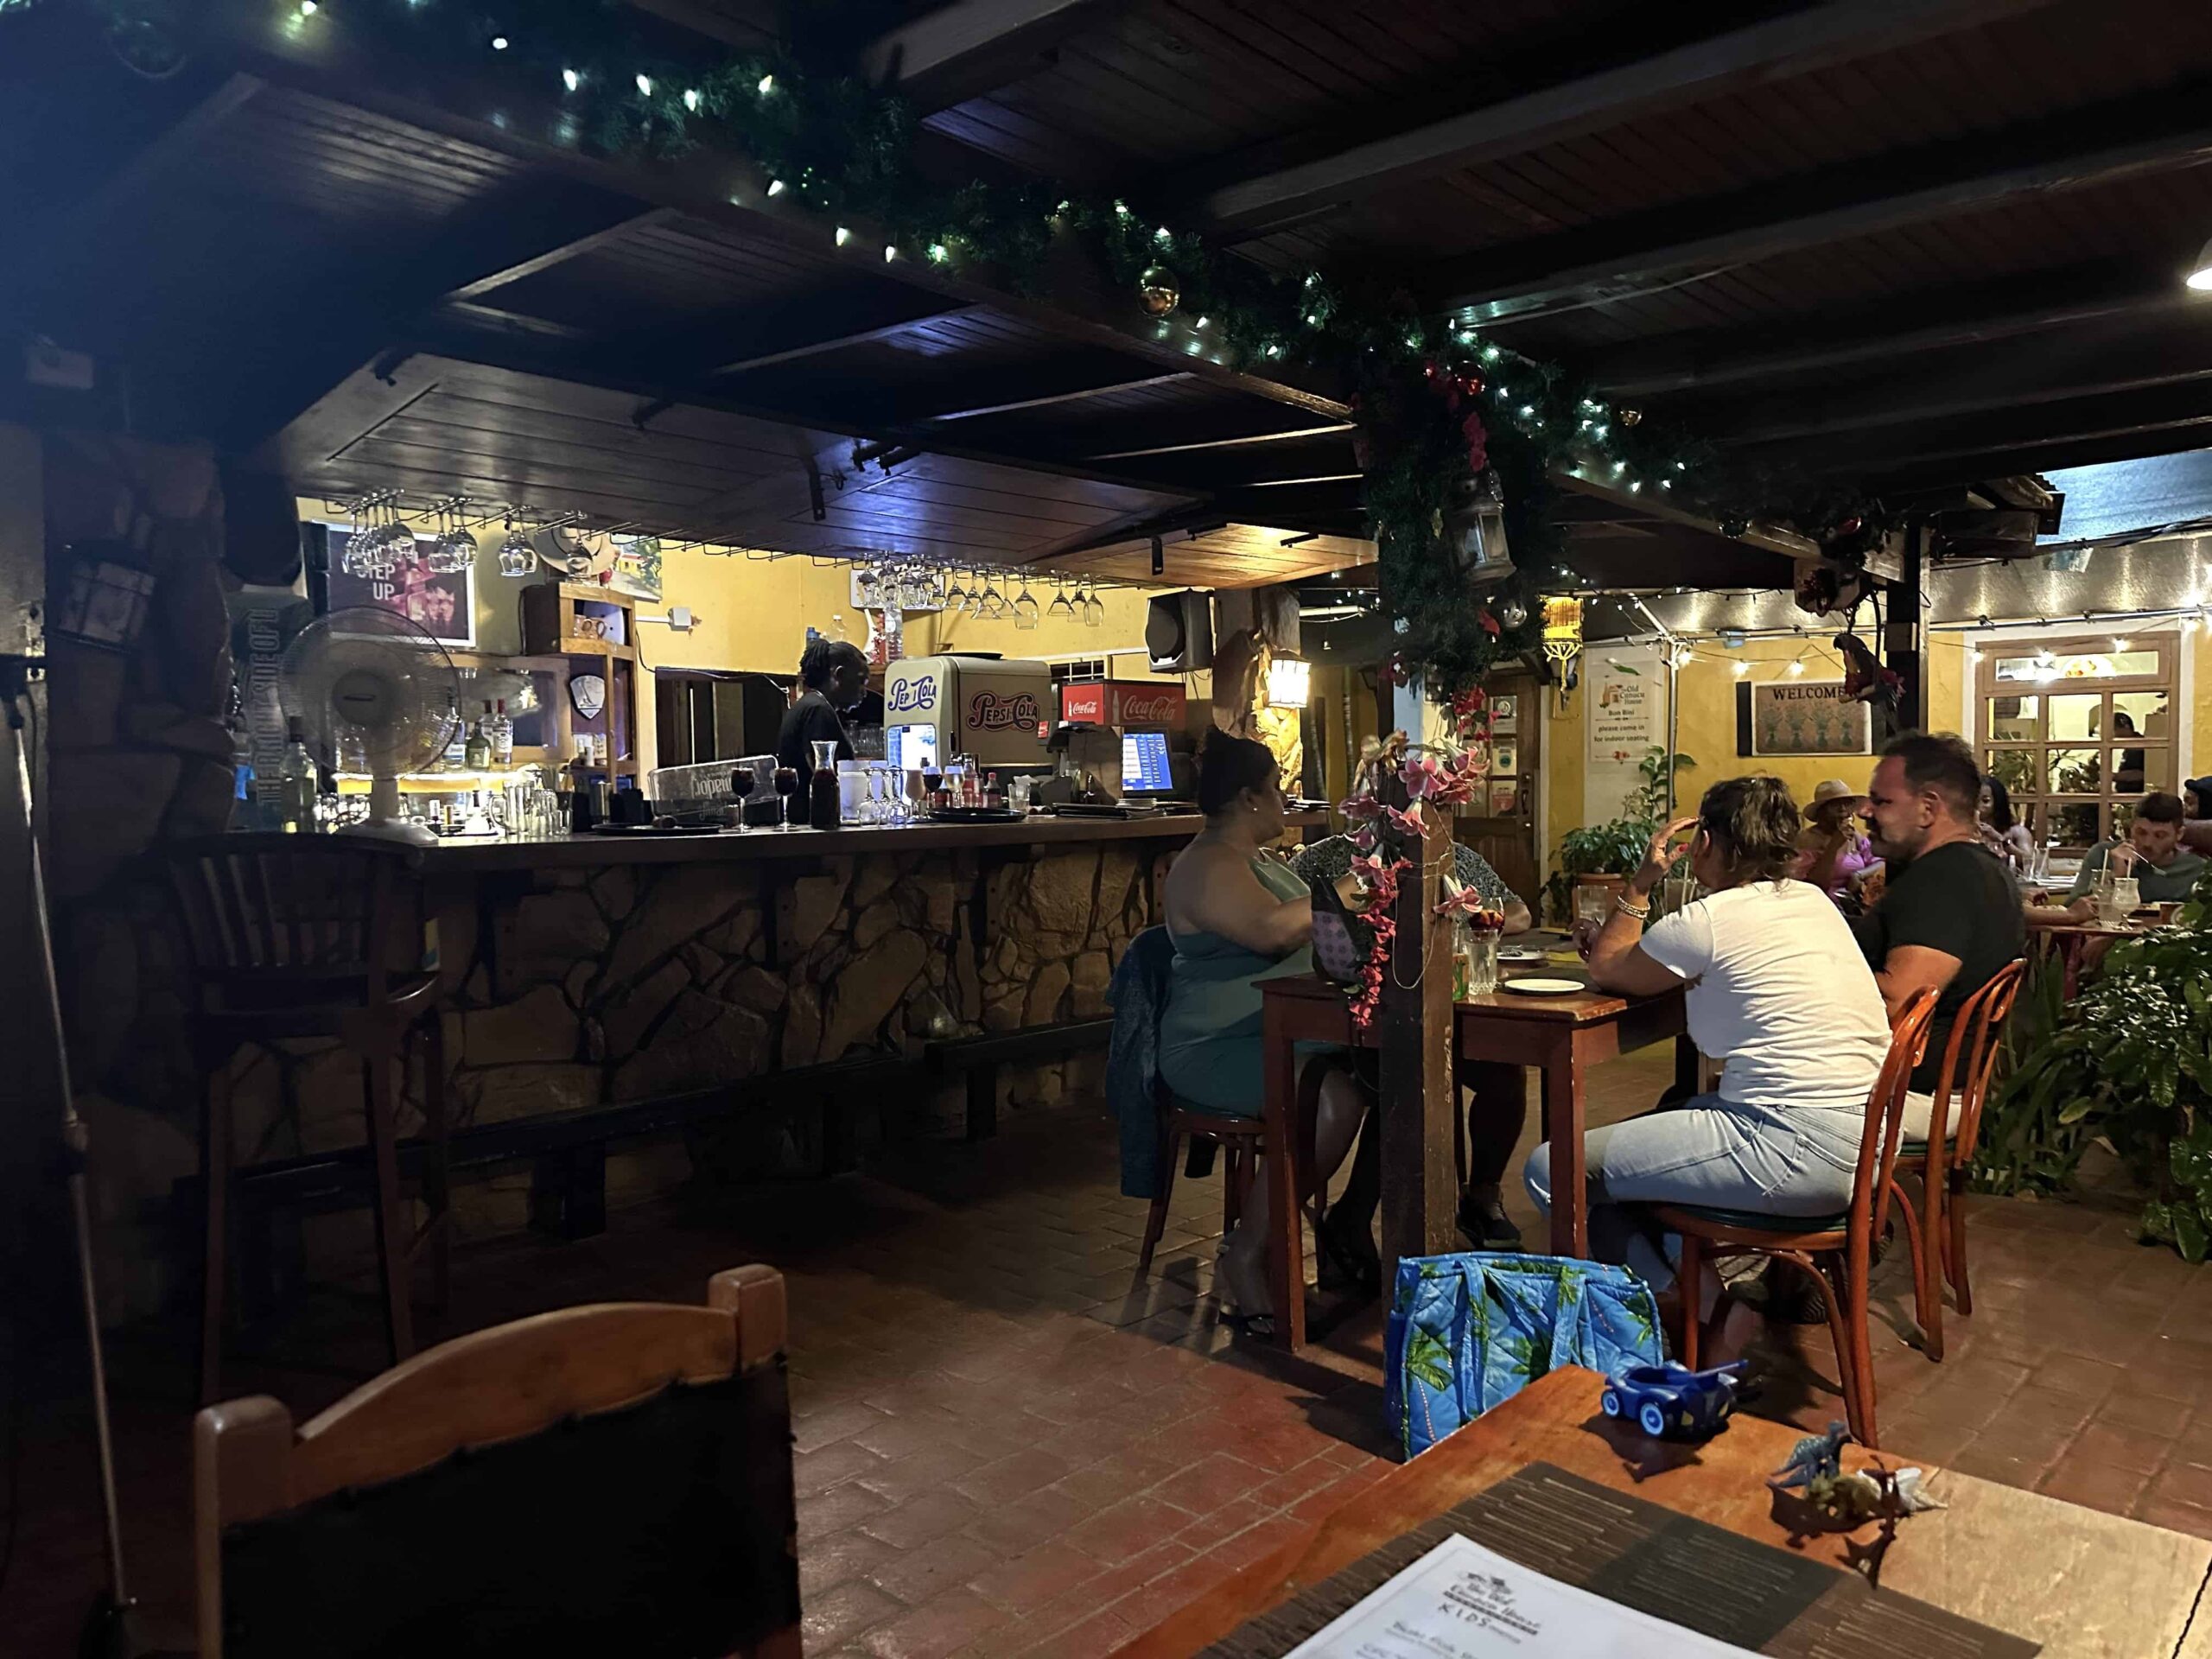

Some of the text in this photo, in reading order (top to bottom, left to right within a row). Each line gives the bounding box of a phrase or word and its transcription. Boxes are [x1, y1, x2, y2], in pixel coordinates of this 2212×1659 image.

[372, 582, 395, 601] UP
[249, 623, 280, 651] OF
[1438, 1603, 1492, 1628] KIDS
